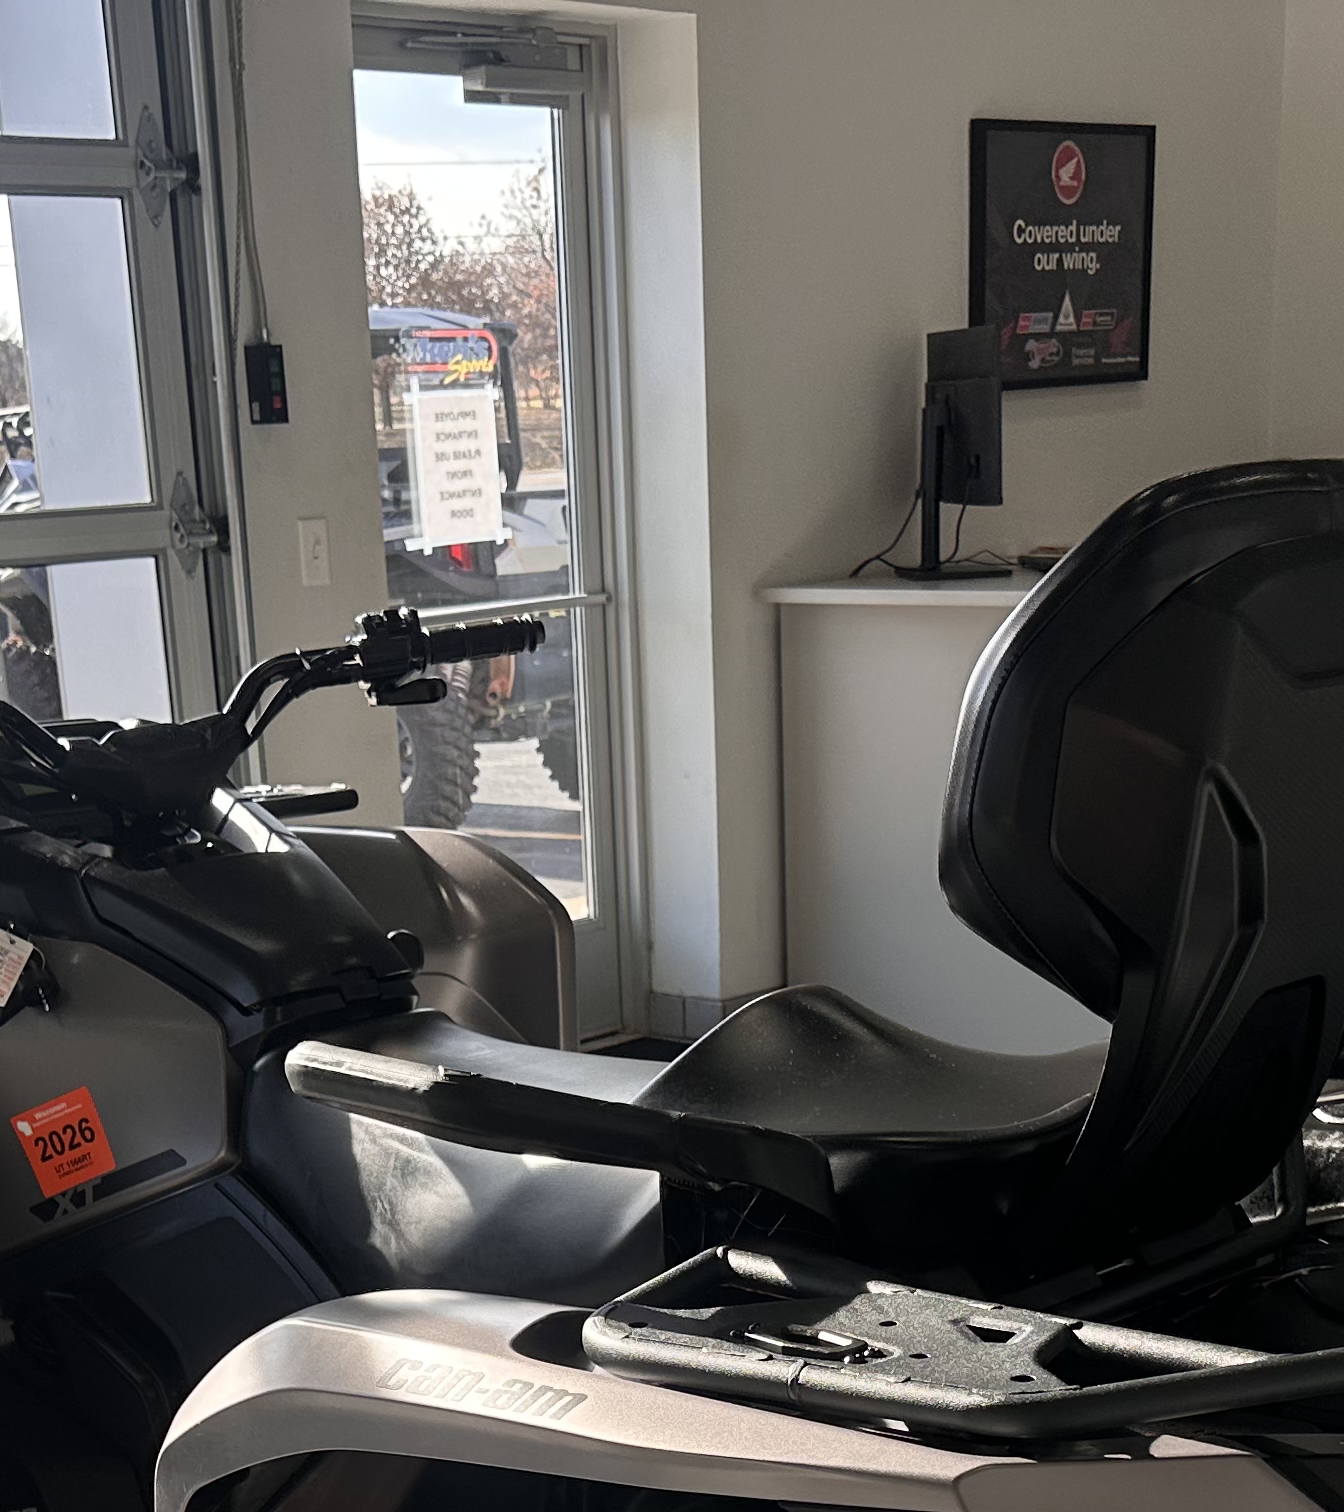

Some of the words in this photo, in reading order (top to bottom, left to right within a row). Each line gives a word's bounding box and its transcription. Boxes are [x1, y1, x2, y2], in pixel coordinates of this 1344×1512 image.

[1013, 219, 1077, 244] Covered
[1080, 220, 1121, 243] under
[1034, 251, 1059, 271] our
[1062, 247, 1100, 275] wing.
[443, 354, 494, 385] Sports
[34, 1117, 95, 1163] 2026
[375, 1357, 589, 1421] can-am
